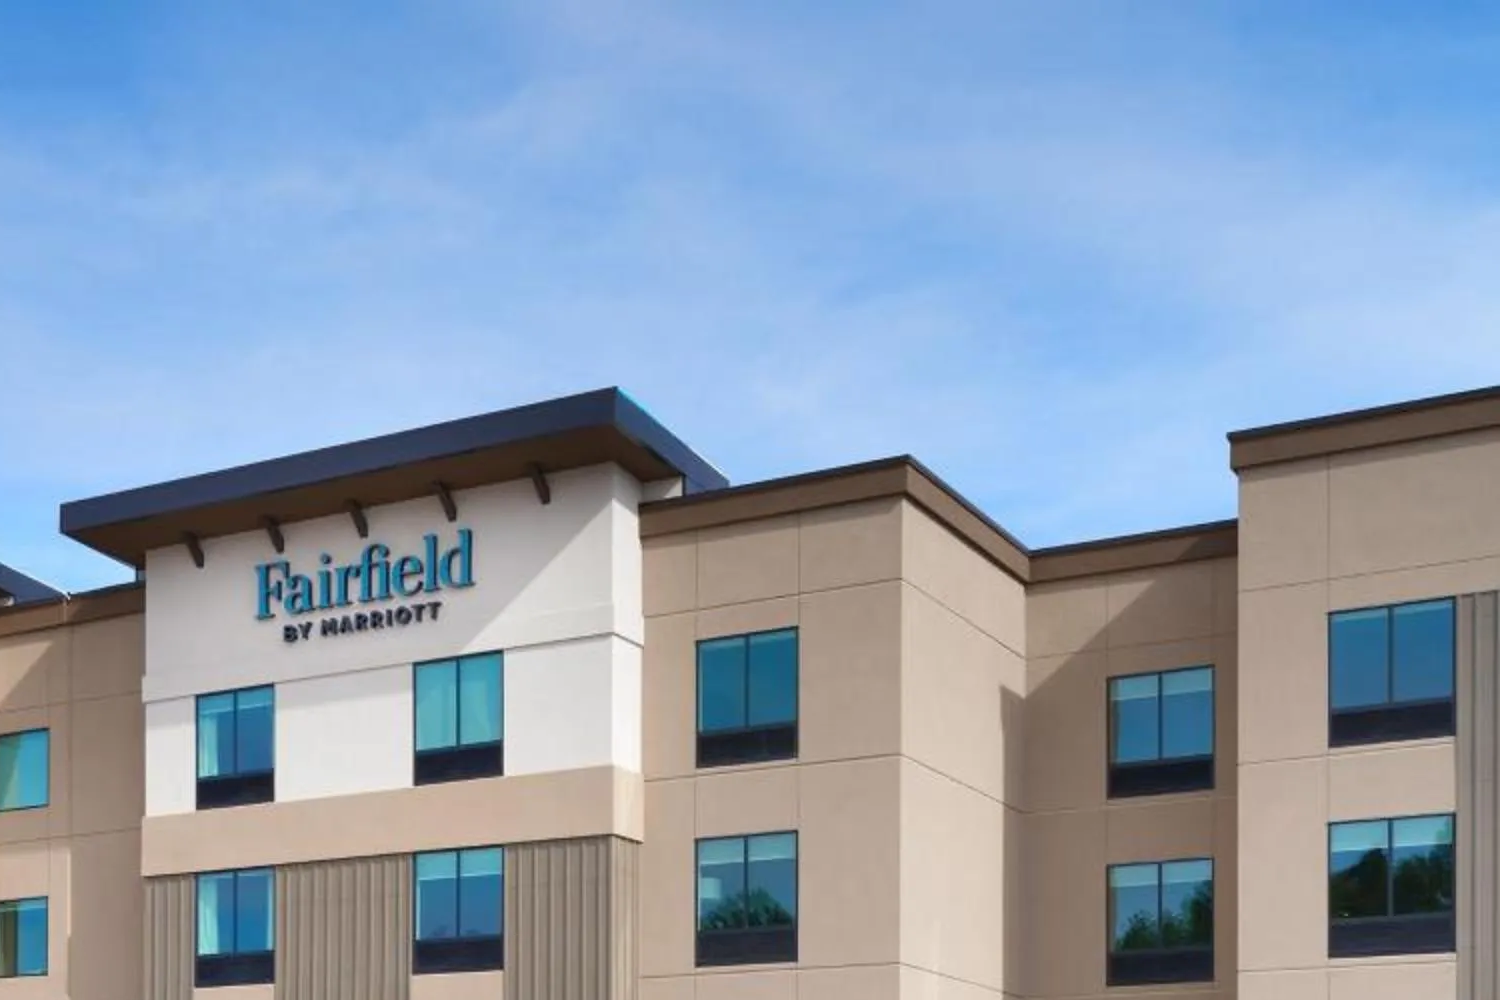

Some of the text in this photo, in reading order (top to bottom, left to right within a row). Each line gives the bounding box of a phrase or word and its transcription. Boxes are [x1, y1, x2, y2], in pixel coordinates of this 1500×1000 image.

[255, 528, 476, 620] Fairfield
[283, 602, 442, 642] BY MARRIOTT
